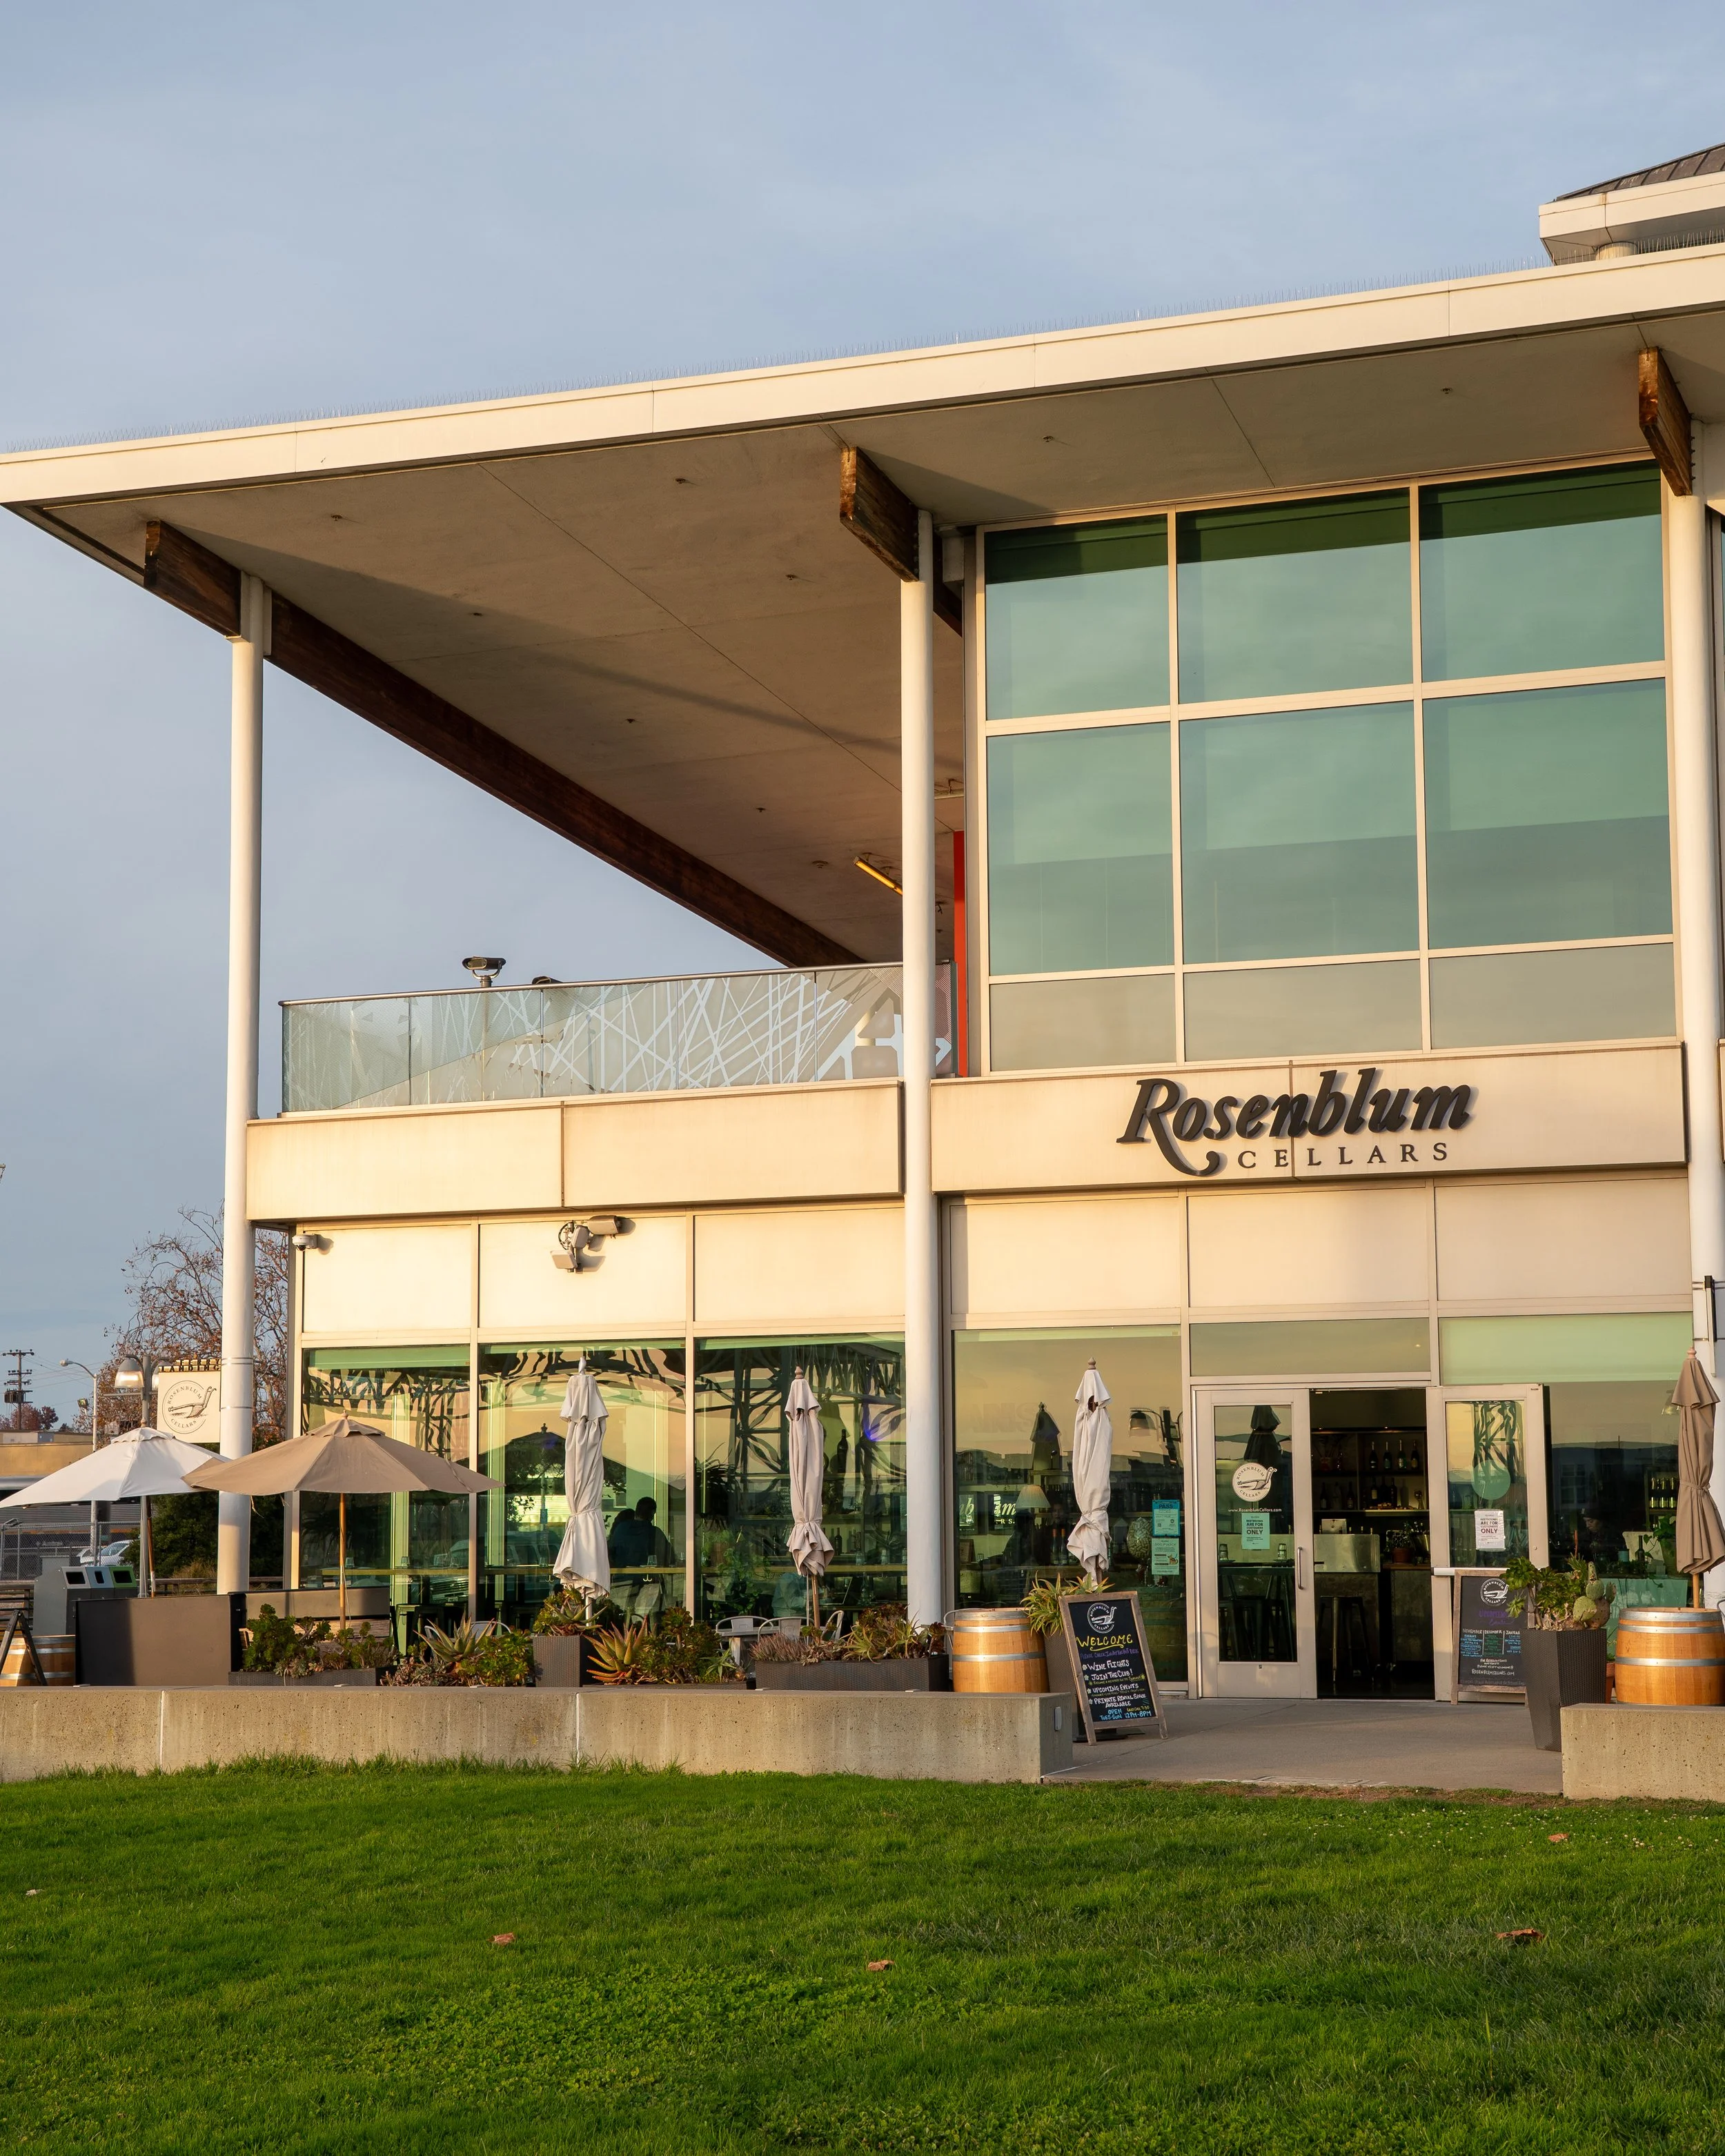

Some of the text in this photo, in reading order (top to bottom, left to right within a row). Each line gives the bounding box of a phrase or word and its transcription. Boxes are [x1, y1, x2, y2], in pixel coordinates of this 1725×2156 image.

[1116, 1067, 1472, 1176] Rosenblum
[1237, 1142, 1448, 1169] CELLARS
[167, 1385, 202, 1405] ROSENBLUM
[170, 1418, 197, 1429] CELLARS
[1236, 1466, 1265, 1480] ROSENBLUM
[1483, 1581, 1504, 1590] ROSENBLUM
[1090, 1605, 1110, 1616] ROSENBLUM
[1076, 1634, 1133, 1648] WELCOME
[1087, 1659, 1130, 1671] WINE FLIGHTS
[1092, 1685, 1119, 1693] UPCOMING
[1094, 1696, 1117, 1705] PRIVATE
